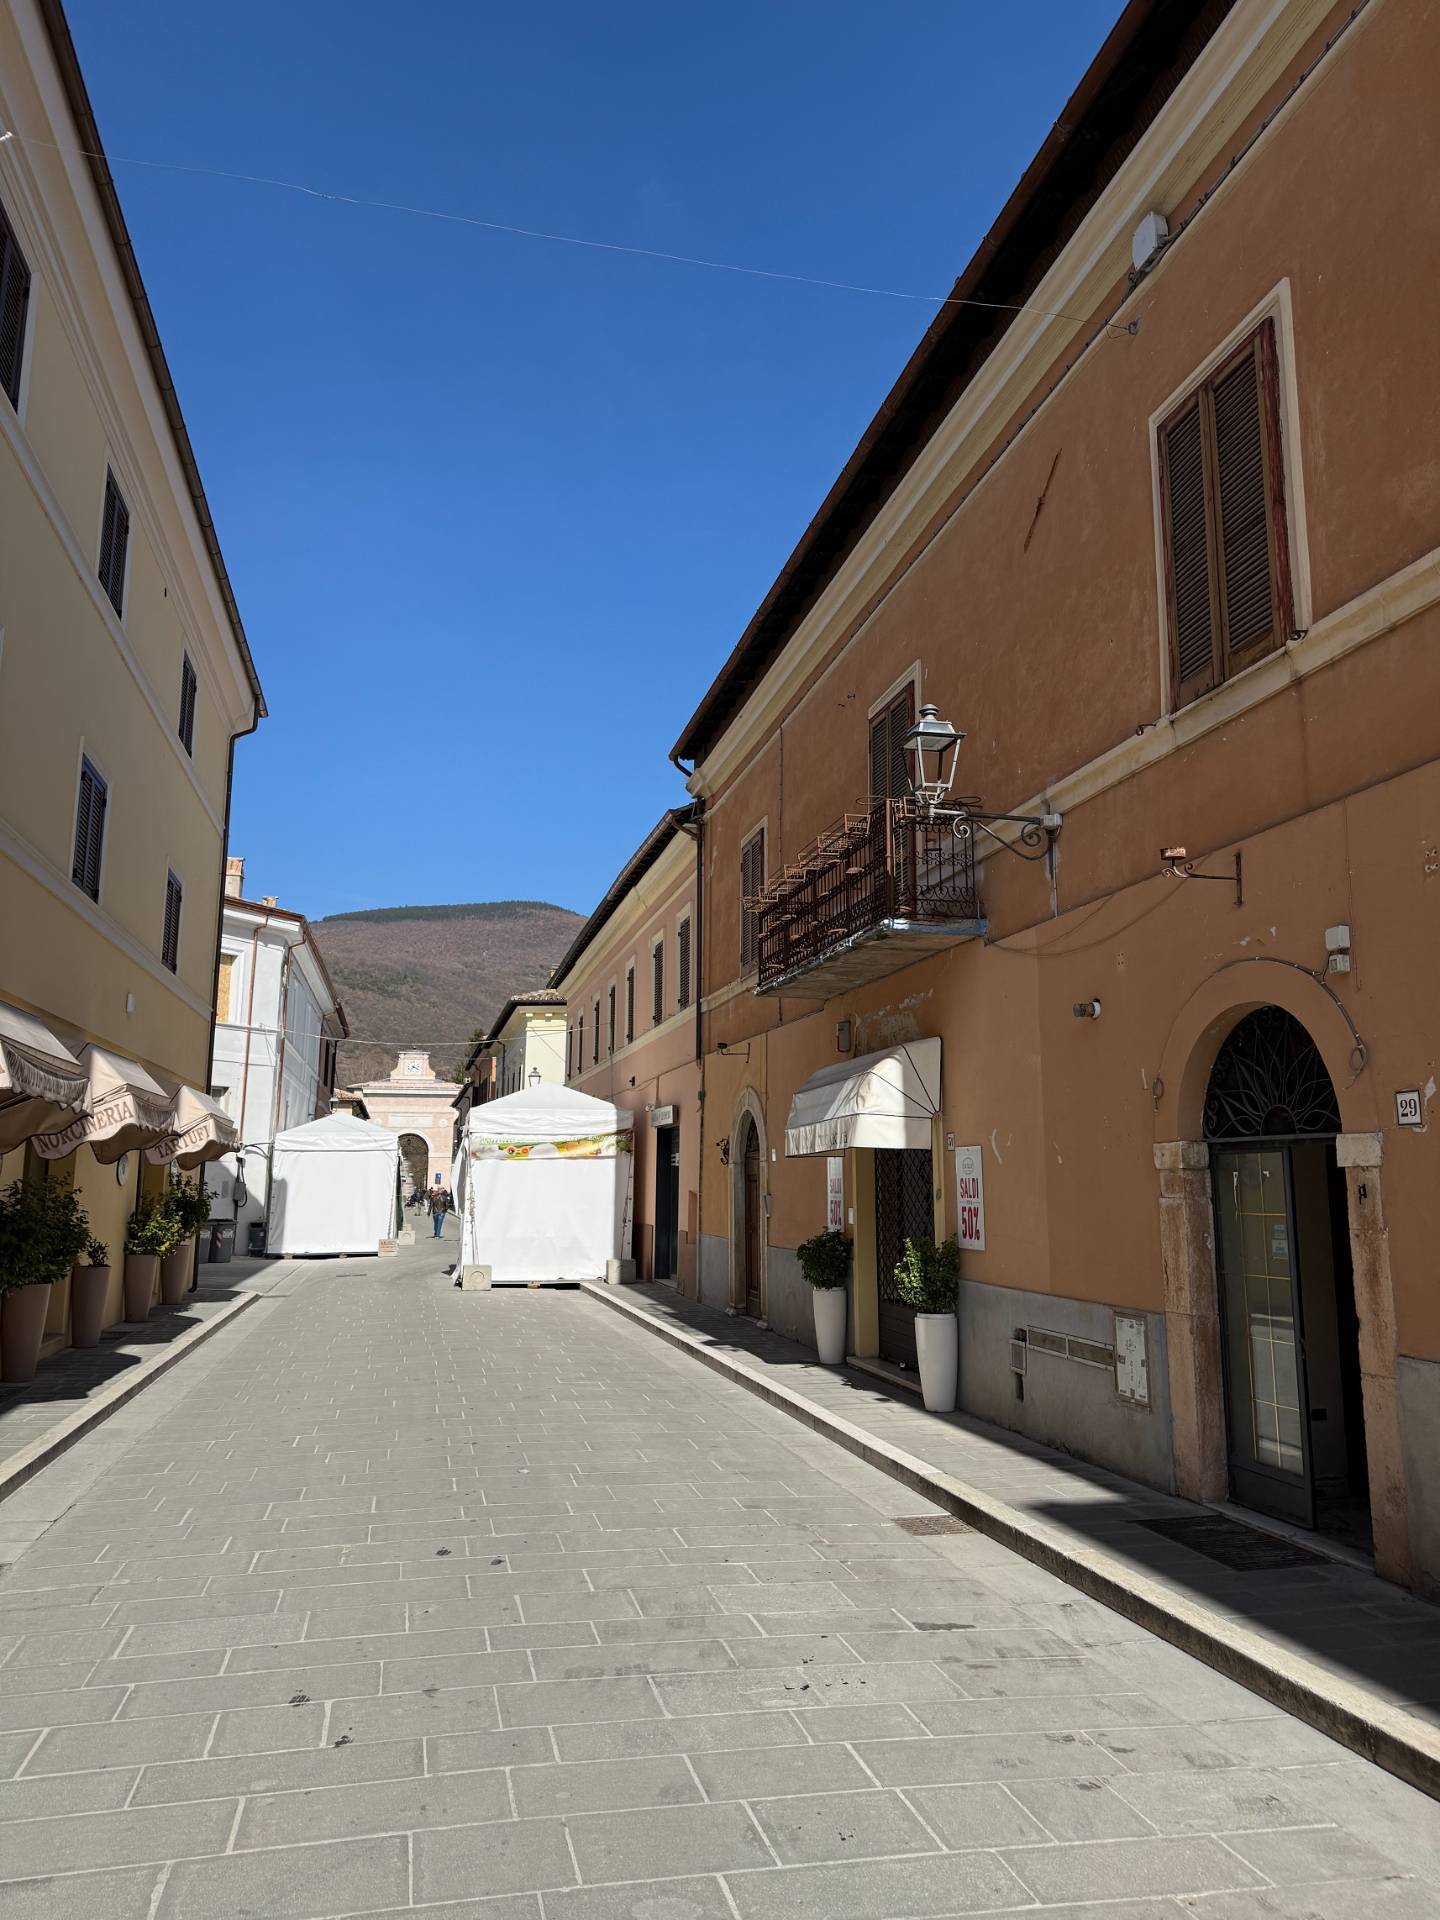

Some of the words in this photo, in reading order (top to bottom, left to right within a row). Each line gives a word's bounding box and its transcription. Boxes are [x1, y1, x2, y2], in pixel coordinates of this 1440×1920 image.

[1400, 1098, 1418, 1117] 29
[35, 1101, 134, 1153] NORCINERIA
[154, 1125, 210, 1158] TARTUFI
[959, 1177, 979, 1199] SALDI
[829, 1200, 842, 1226] 50%
[961, 1206, 981, 1240] 50%
